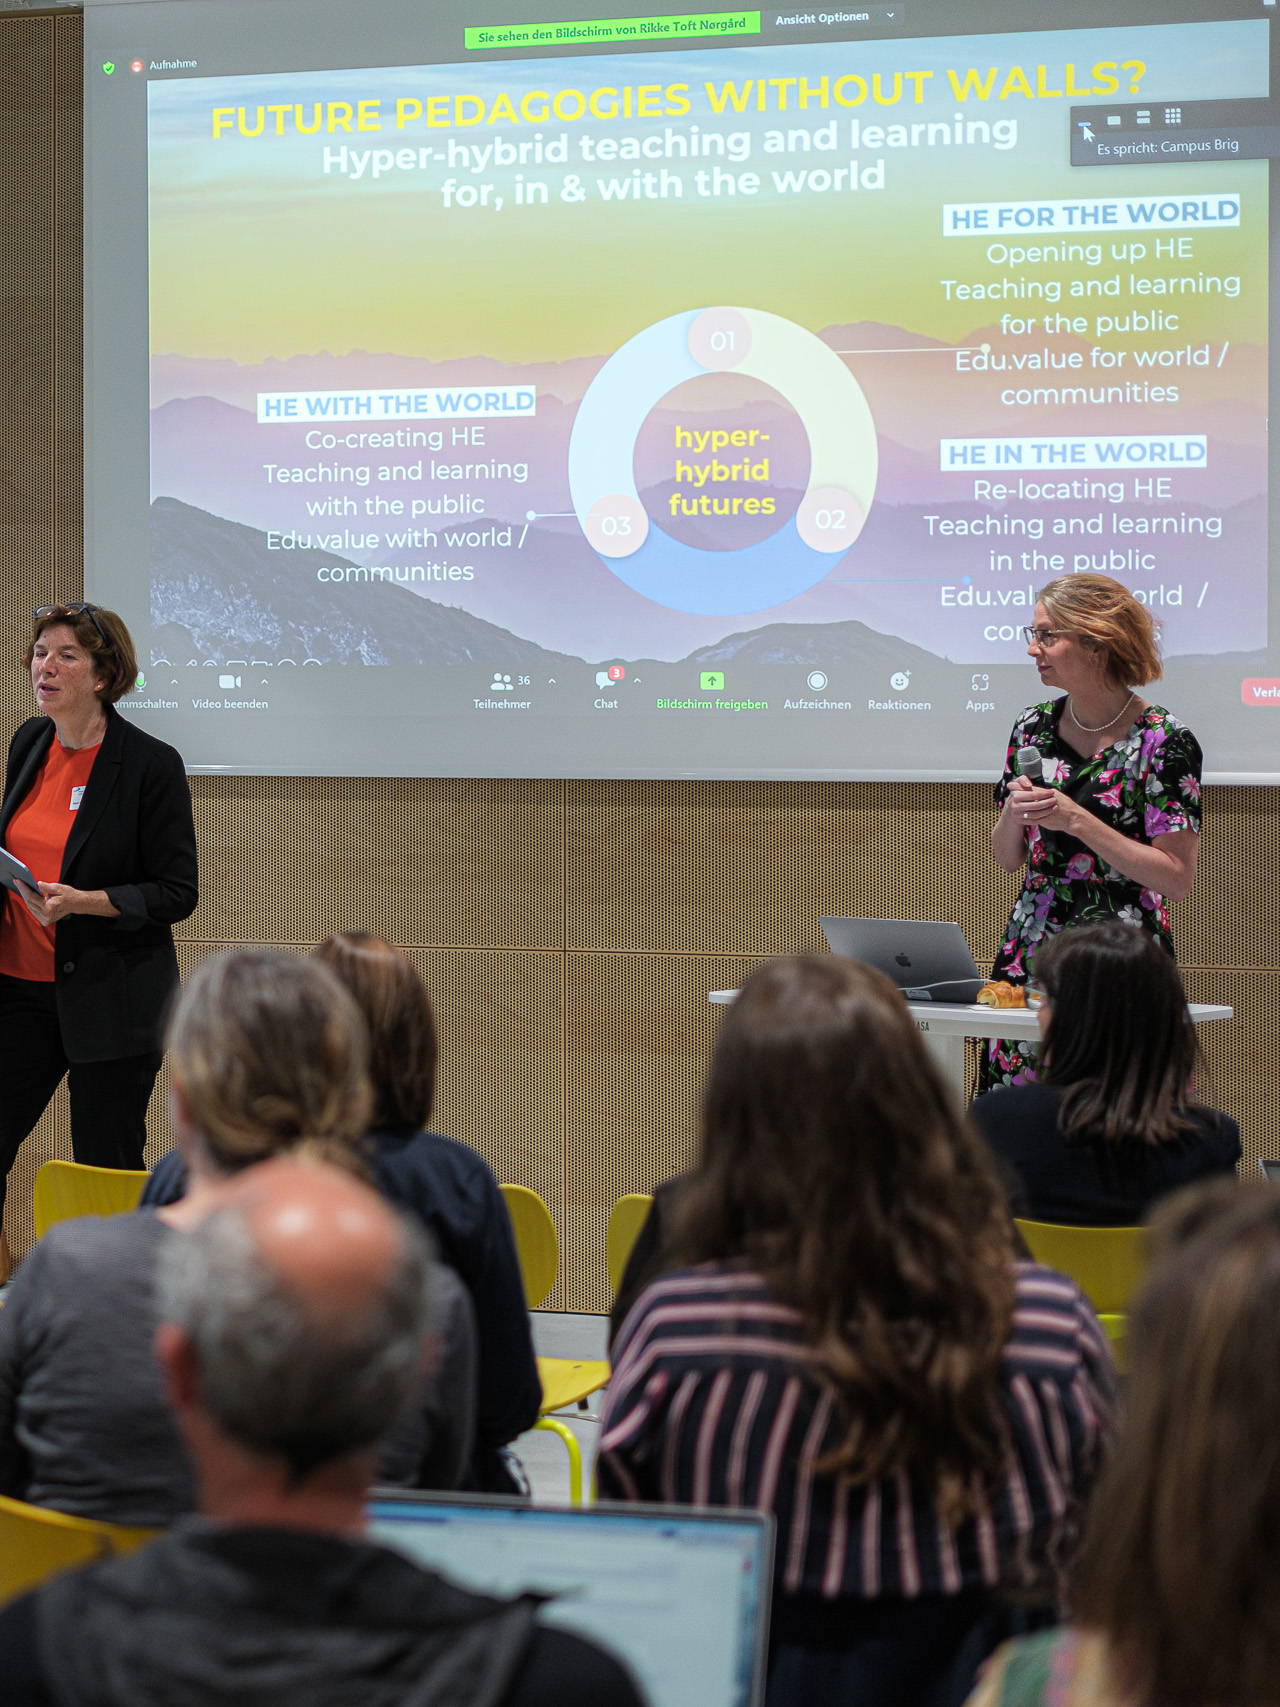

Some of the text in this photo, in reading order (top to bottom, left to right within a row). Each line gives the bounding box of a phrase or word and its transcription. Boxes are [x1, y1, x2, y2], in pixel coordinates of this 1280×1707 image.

[478, 17, 746, 43] Sie sehen den Bildschirm von Rikke Toft Nørgård
[775, 11, 870, 26] Ansicht Optionen
[149, 58, 198, 71] Aufnahme
[212, 59, 1147, 140] FUTURE PEDAGOGIES WITHOUT WALLS?
[322, 112, 1019, 180] Hyper-hybrid teaching and learning
[1097, 138, 1239, 157] Es spricht: Campus Brig
[441, 158, 886, 211] for, in & with the world
[951, 199, 1240, 230] HE FOR THE WORLD
[986, 237, 1194, 266] Opening up HE
[940, 269, 1242, 302] Teaching and learning
[1000, 308, 1180, 339] for the public
[710, 330, 736, 352] 01
[955, 341, 1230, 374] Edu.value for world /
[264, 391, 535, 417] HE WITH THE WORLD
[1000, 382, 1179, 406] communities
[305, 426, 486, 453] Co-creating HE
[675, 425, 770, 453] hyper-
[949, 440, 1207, 465] HE IN THE WORLD
[263, 458, 529, 487] Teaching and learning
[675, 457, 770, 487] hybrid
[973, 477, 1172, 505] Re-locating HE
[305, 492, 486, 520] with the public
[668, 492, 776, 516] futures
[600, 516, 632, 537] 03
[814, 508, 847, 530] 02
[923, 510, 1223, 541] Teaching and learning
[266, 523, 530, 552] Edu.value with world /
[316, 561, 475, 584] communities
[989, 548, 1156, 573] in the public
[941, 581, 1209, 608] Edu.val orld /
[517, 675, 531, 686] 36
[613, 668, 620, 679] 3
[114, 699, 179, 709] ummschalten
[192, 699, 269, 709] Video beenden
[473, 699, 532, 710] Teilnehmer
[594, 699, 618, 710] Chat
[656, 699, 769, 713] Bildschirm freigeben
[783, 699, 852, 711] Aufzeichnen
[868, 699, 932, 711] Reaktionen
[965, 700, 995, 713] Apps
